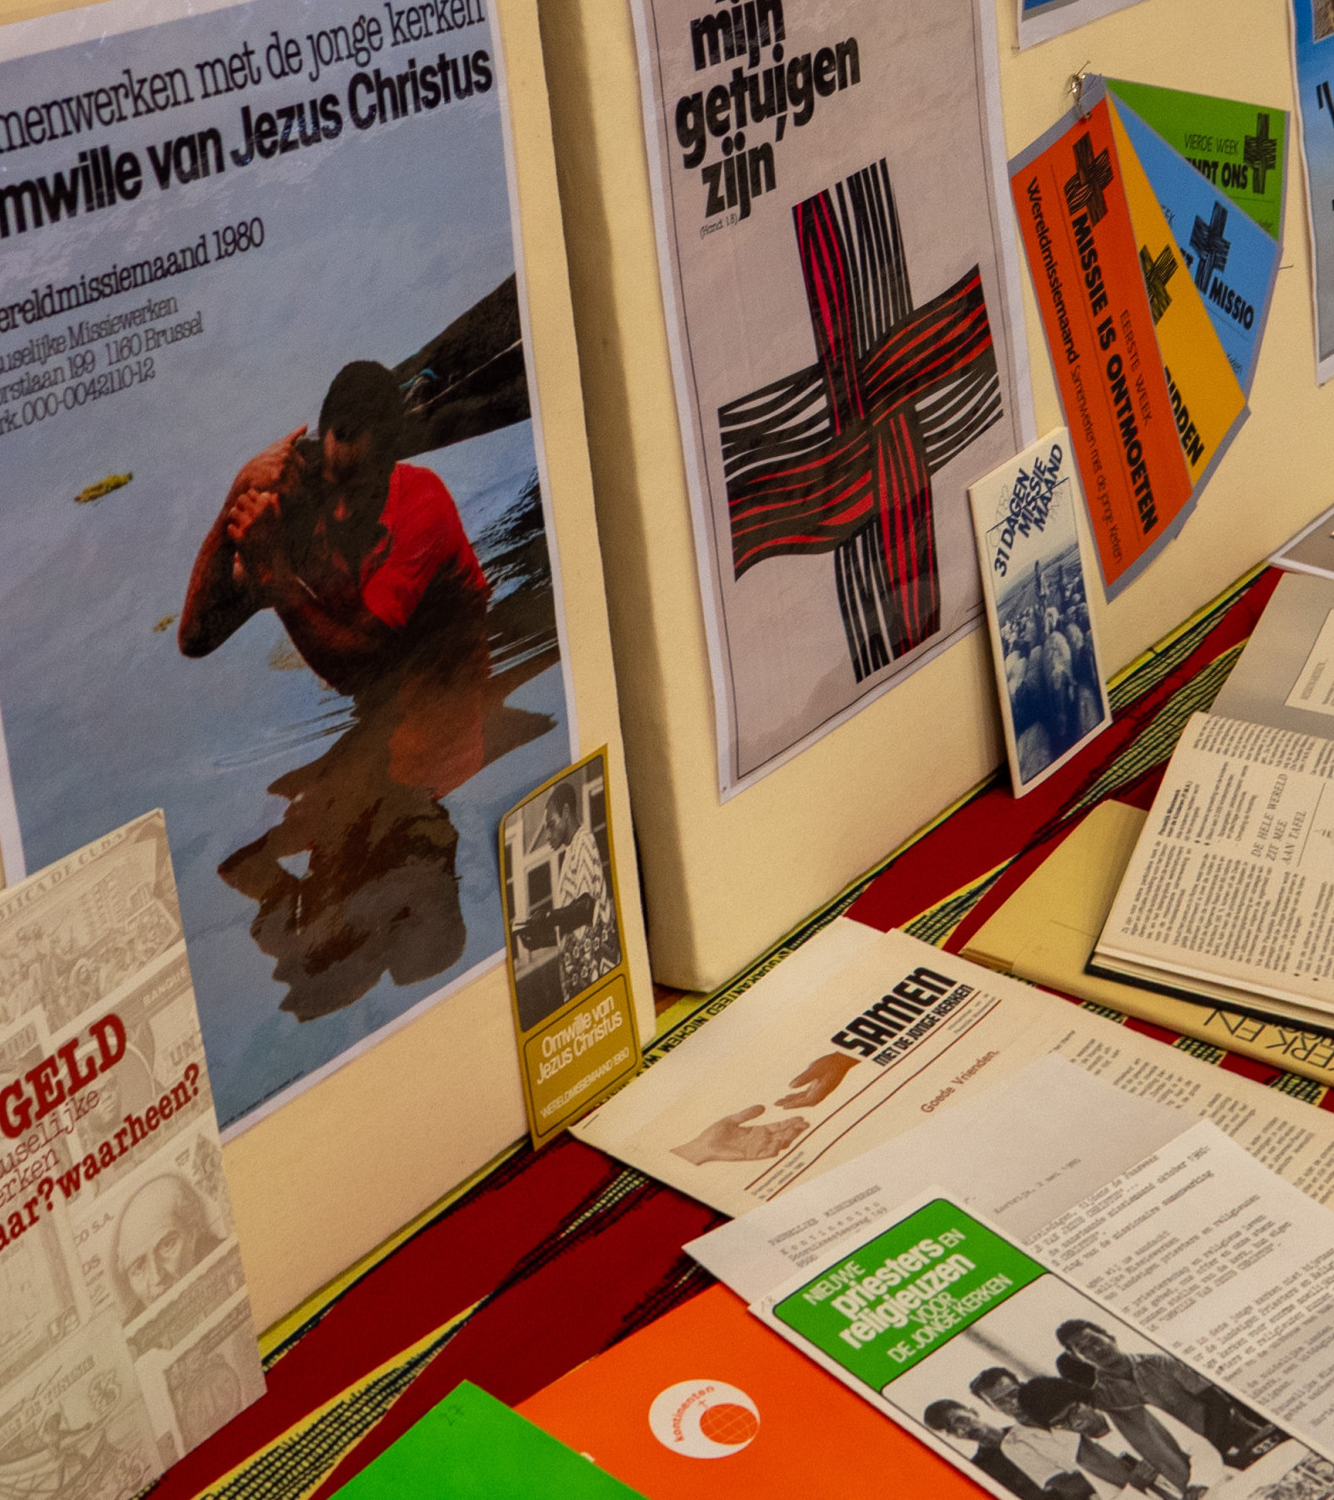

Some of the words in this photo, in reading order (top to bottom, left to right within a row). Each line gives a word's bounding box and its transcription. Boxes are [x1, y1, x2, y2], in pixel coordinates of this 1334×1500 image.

[196, 41, 262, 98] met
[267, 32, 303, 80] de
[308, 15, 383, 84] jonge
[148, 124, 224, 188] van
[231, 93, 343, 167] Jezus
[349, 48, 494, 131] Christus
[675, 36, 861, 170] getuigen
[1184, 133, 1213, 154] VIERDE
[1216, 137, 1239, 156] WEEK
[212, 217, 265, 261] 1980
[1072, 216, 1109, 317] MISSIE
[68, 296, 179, 350] Missiewerken
[68, 350, 96, 379] 199
[105, 332, 143, 367] 1160
[144, 311, 205, 353] Brussel
[1097, 316, 1116, 351] IS
[1208, 276, 1255, 331] MISSIO
[1120, 310, 1140, 373] EERSTE
[1134, 373, 1153, 426] WEEK
[1106, 353, 1159, 536] ONTMOETEN
[1001, 467, 1030, 547] DAGEN
[1018, 456, 1048, 539] MISSIE
[1034, 443, 1064, 534] MAAND
[994, 547, 1011, 578] 31
[1251, 840, 1263, 858] DE
[1257, 812, 1274, 839] HELE
[1269, 772, 1288, 811] WERELD
[541, 1010, 591, 1060] Omwille
[591, 992, 615, 1023] van
[707, 959, 780, 1015] GUARANTEED
[831, 967, 957, 1058] SAMEN
[872, 1047, 901, 1067] MET
[892, 1036, 914, 1051] DE
[906, 1013, 939, 1041] JONGE
[931, 984, 975, 1017] KERKEN
[536, 1044, 574, 1087] Jezus
[573, 1012, 624, 1060] Christus
[58, 1063, 201, 1199] waarheen?
[802, 1260, 865, 1305] NIEUWE
[831, 1238, 945, 1322] priesters
[938, 1228, 966, 1248] EN
[838, 1253, 976, 1350] religieuzen
[909, 1291, 957, 1326] VOOR
[887, 1340, 916, 1363] DE
[911, 1312, 961, 1349] JONGE
[953, 1273, 1014, 1318] KERKEN
[673, 1386, 715, 1442] kontinenten
